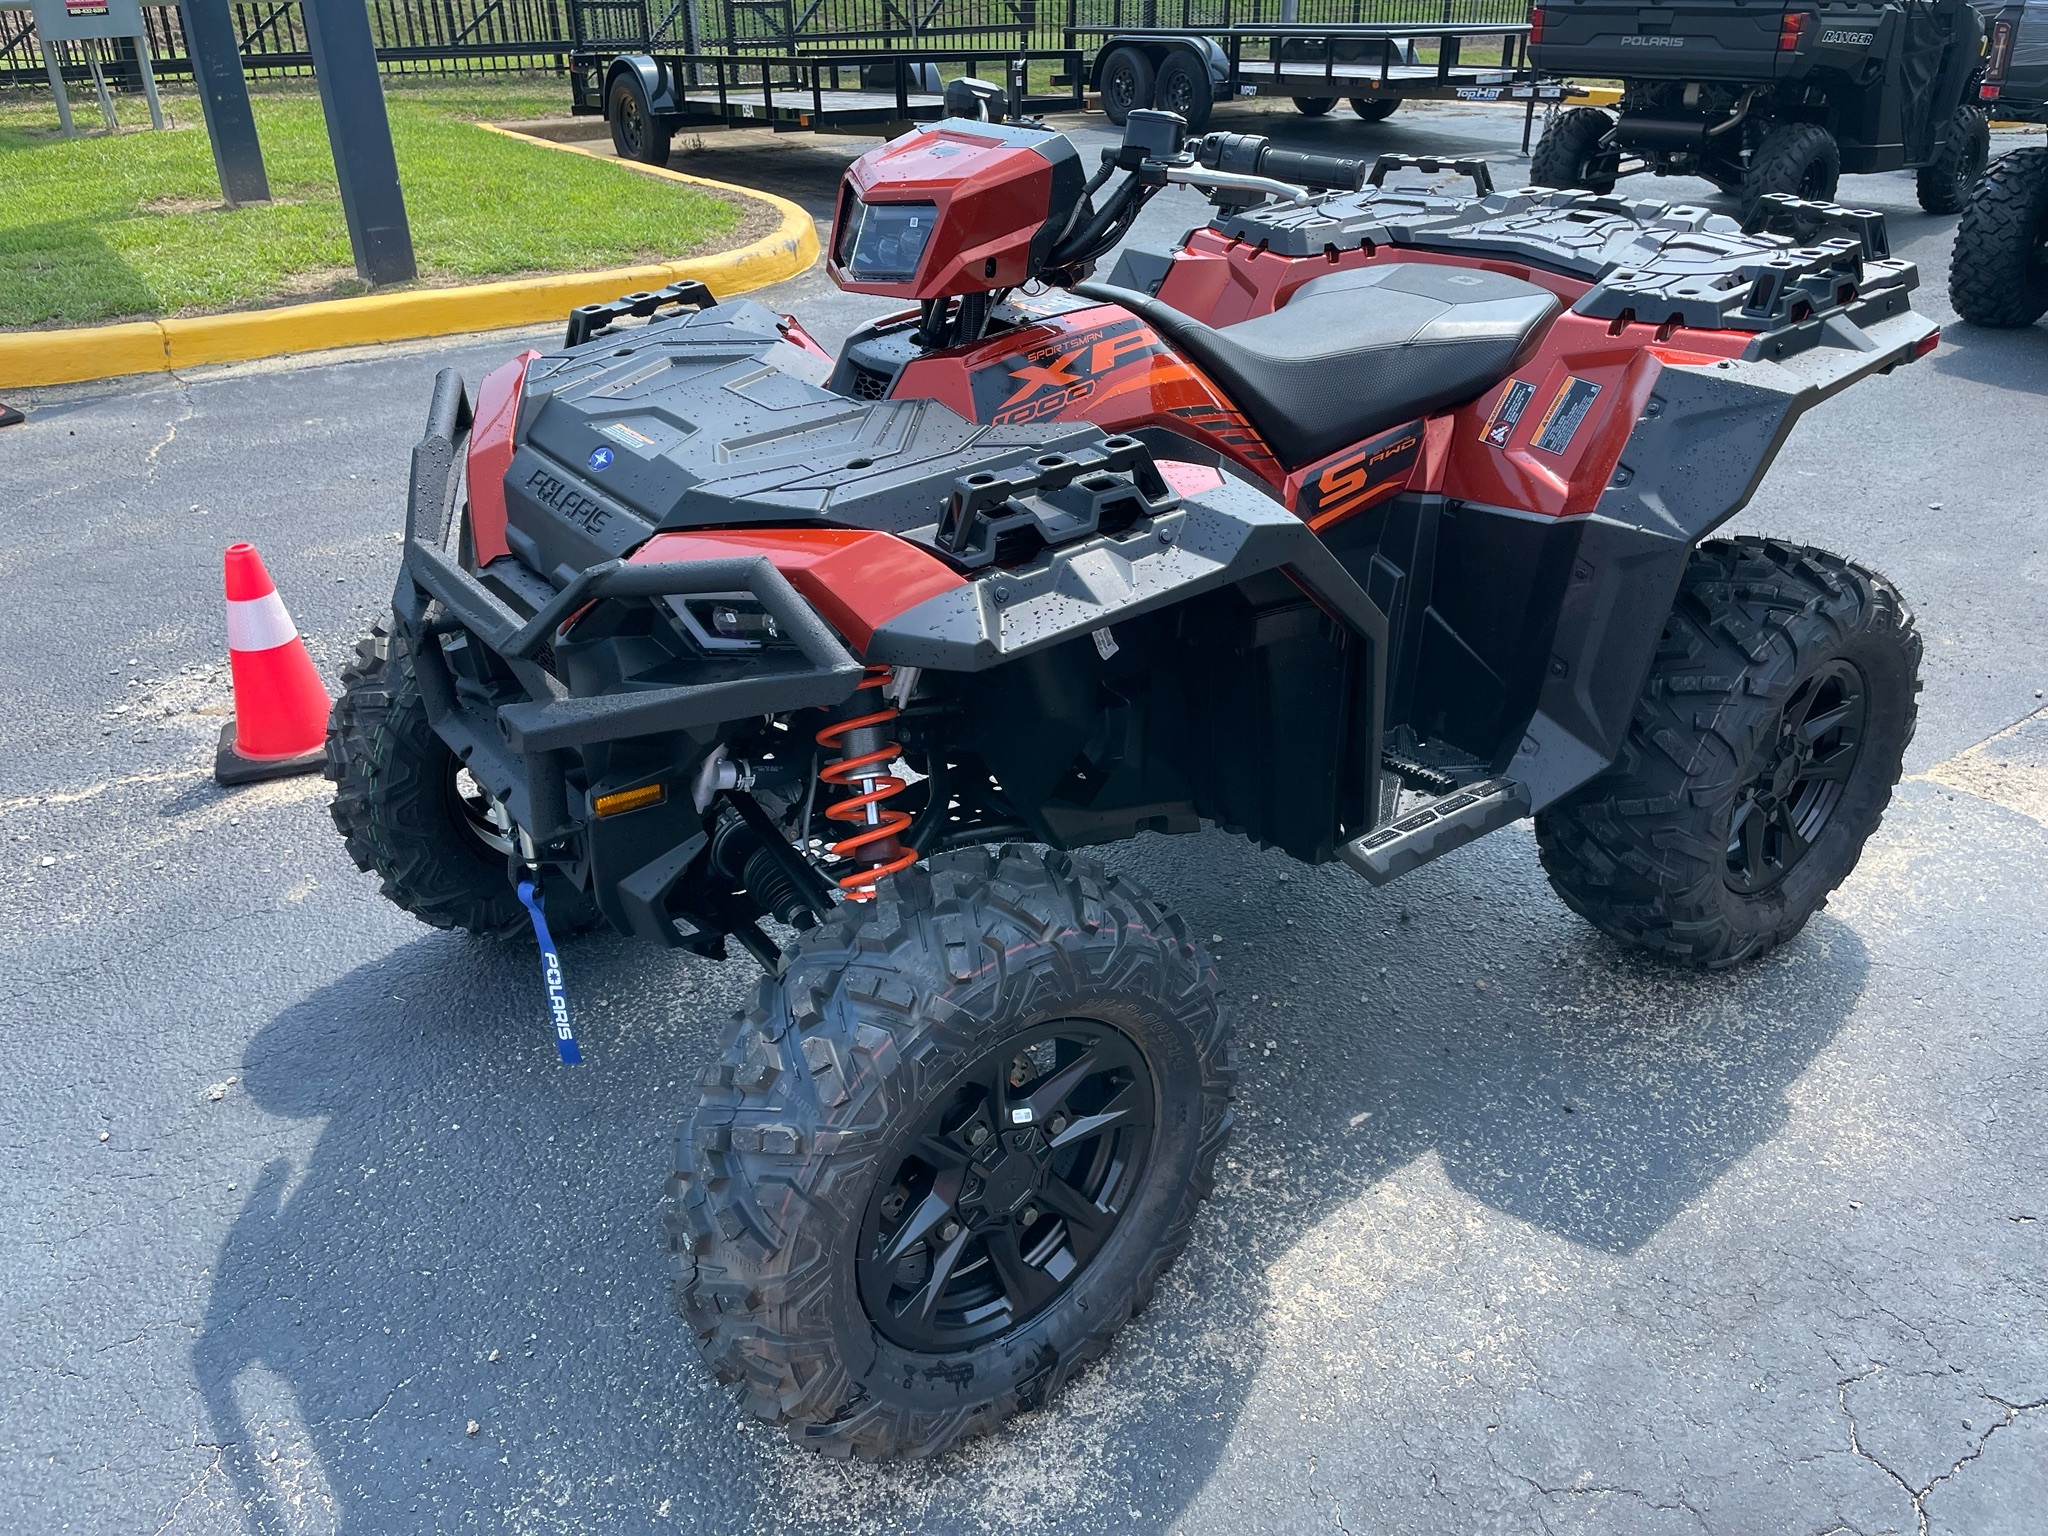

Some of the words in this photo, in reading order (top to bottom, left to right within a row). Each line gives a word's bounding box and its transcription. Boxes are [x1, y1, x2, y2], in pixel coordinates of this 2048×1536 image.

[1621, 36, 1684, 47] POLARIS
[1821, 30, 1874, 45] RANGER
[997, 328, 1158, 410] XP
[1027, 330, 1104, 363] SPORTSMAN
[992, 379, 1096, 427] 1000
[1318, 451, 1368, 508] S
[1369, 438, 1417, 466] AWD
[525, 469, 614, 537] POLARIS
[544, 952, 573, 1041] POLARIS
